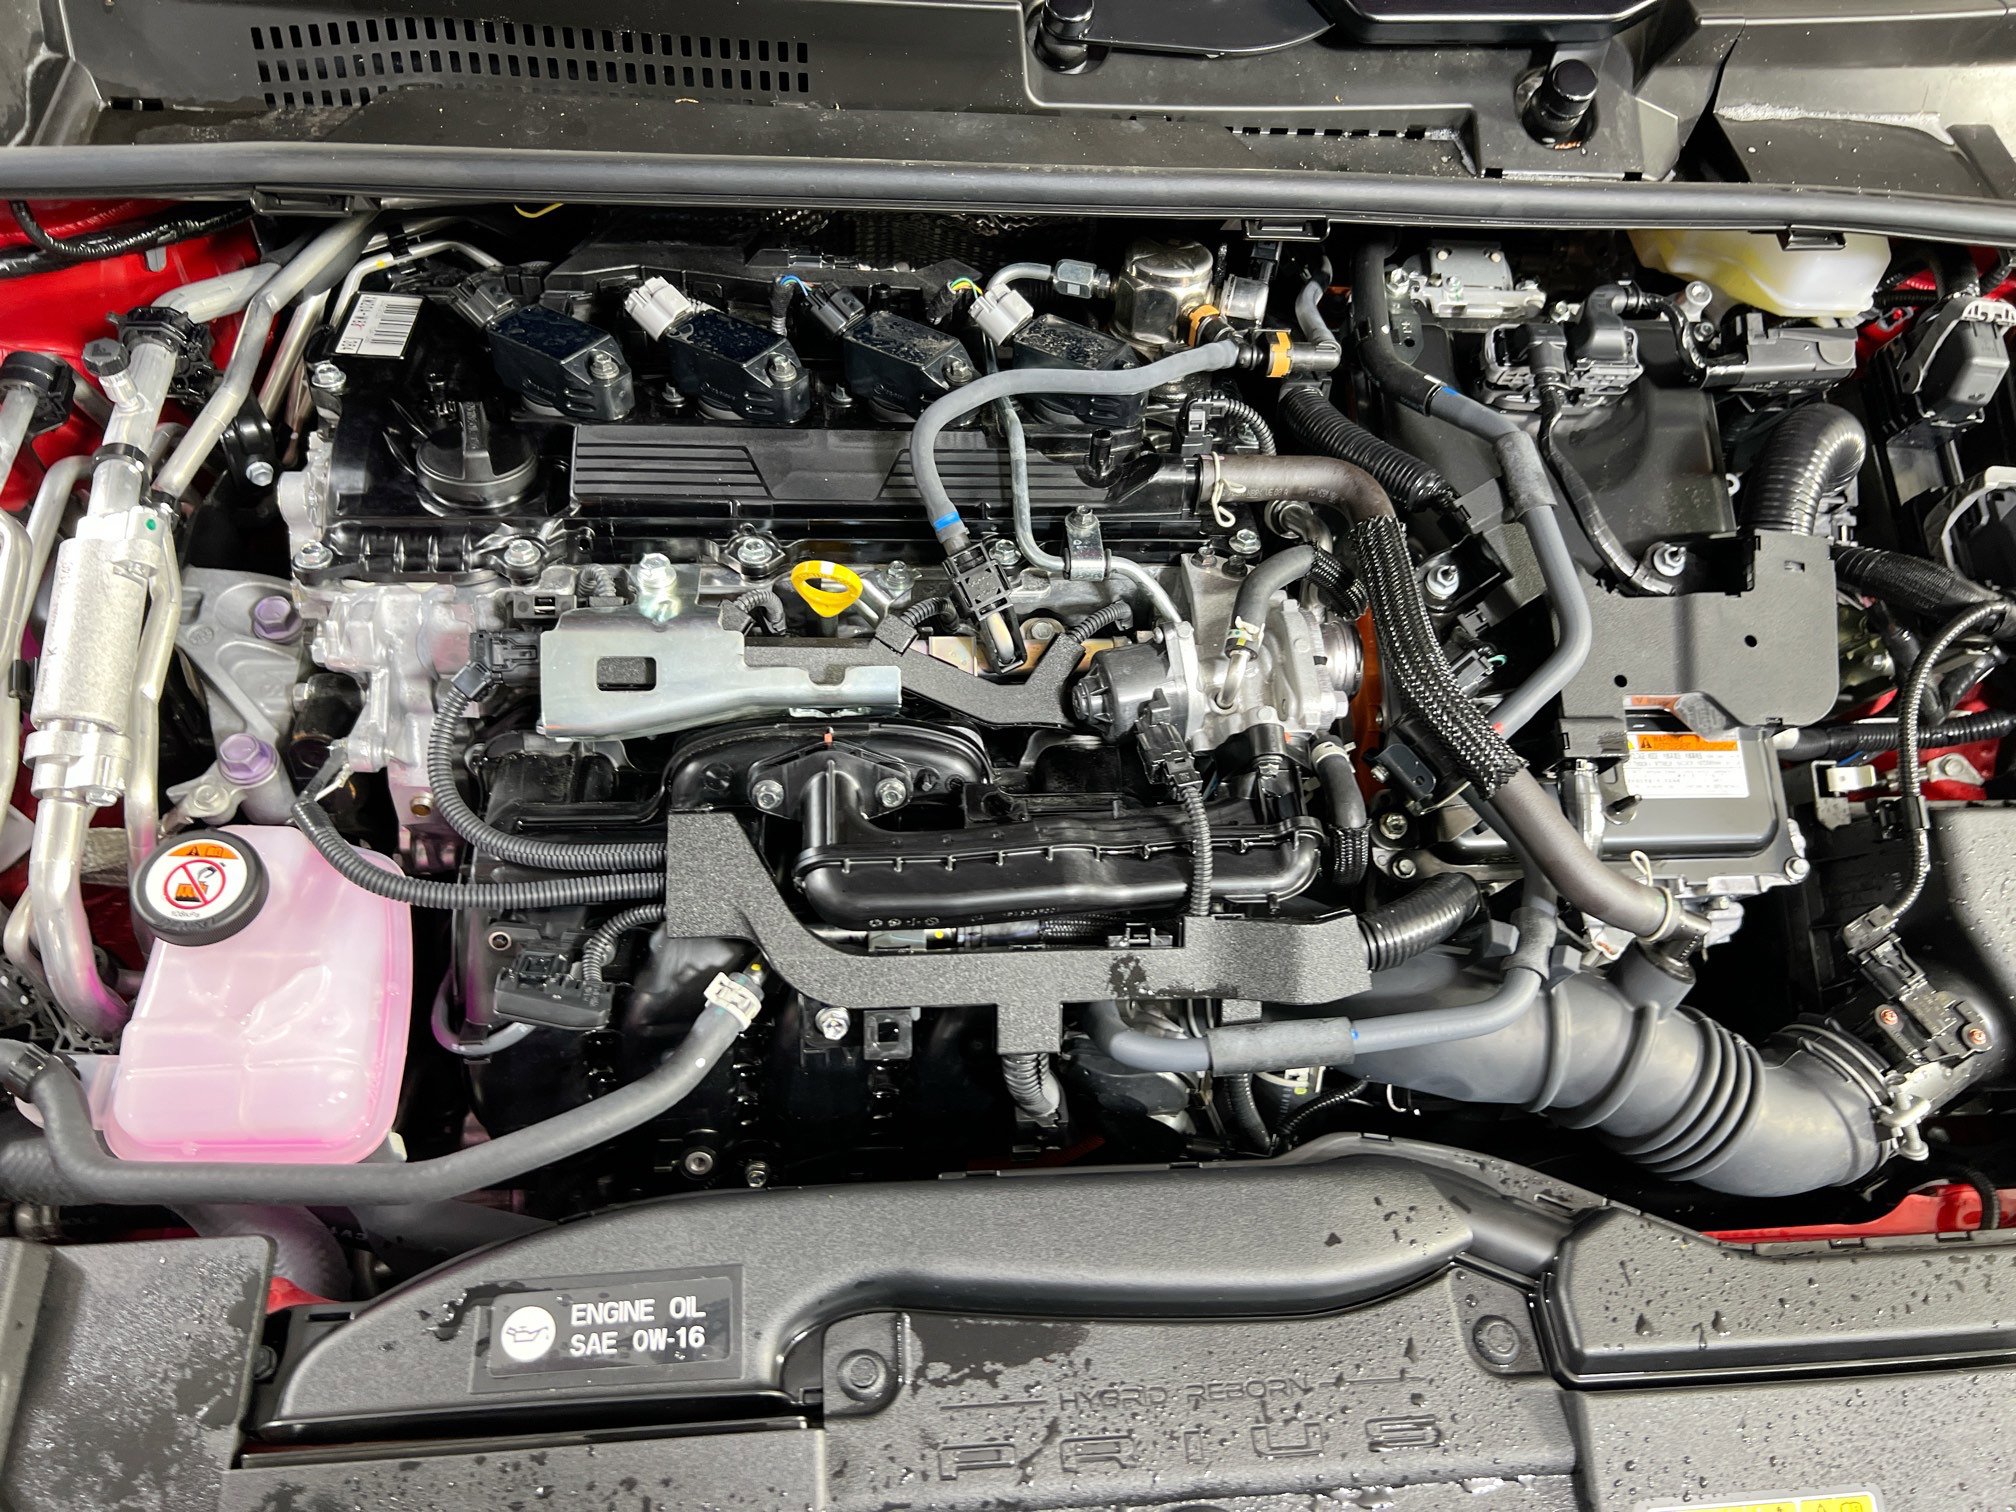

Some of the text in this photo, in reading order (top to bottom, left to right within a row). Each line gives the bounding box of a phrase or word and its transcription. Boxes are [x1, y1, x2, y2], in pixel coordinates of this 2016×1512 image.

[571, 1295, 707, 1326] ENGINE OIL
[570, 1326, 705, 1357] SAE 0W-16
[1059, 1377, 1310, 1411] HYBRID REBORN
[938, 1415, 1441, 1480] PRIUS
